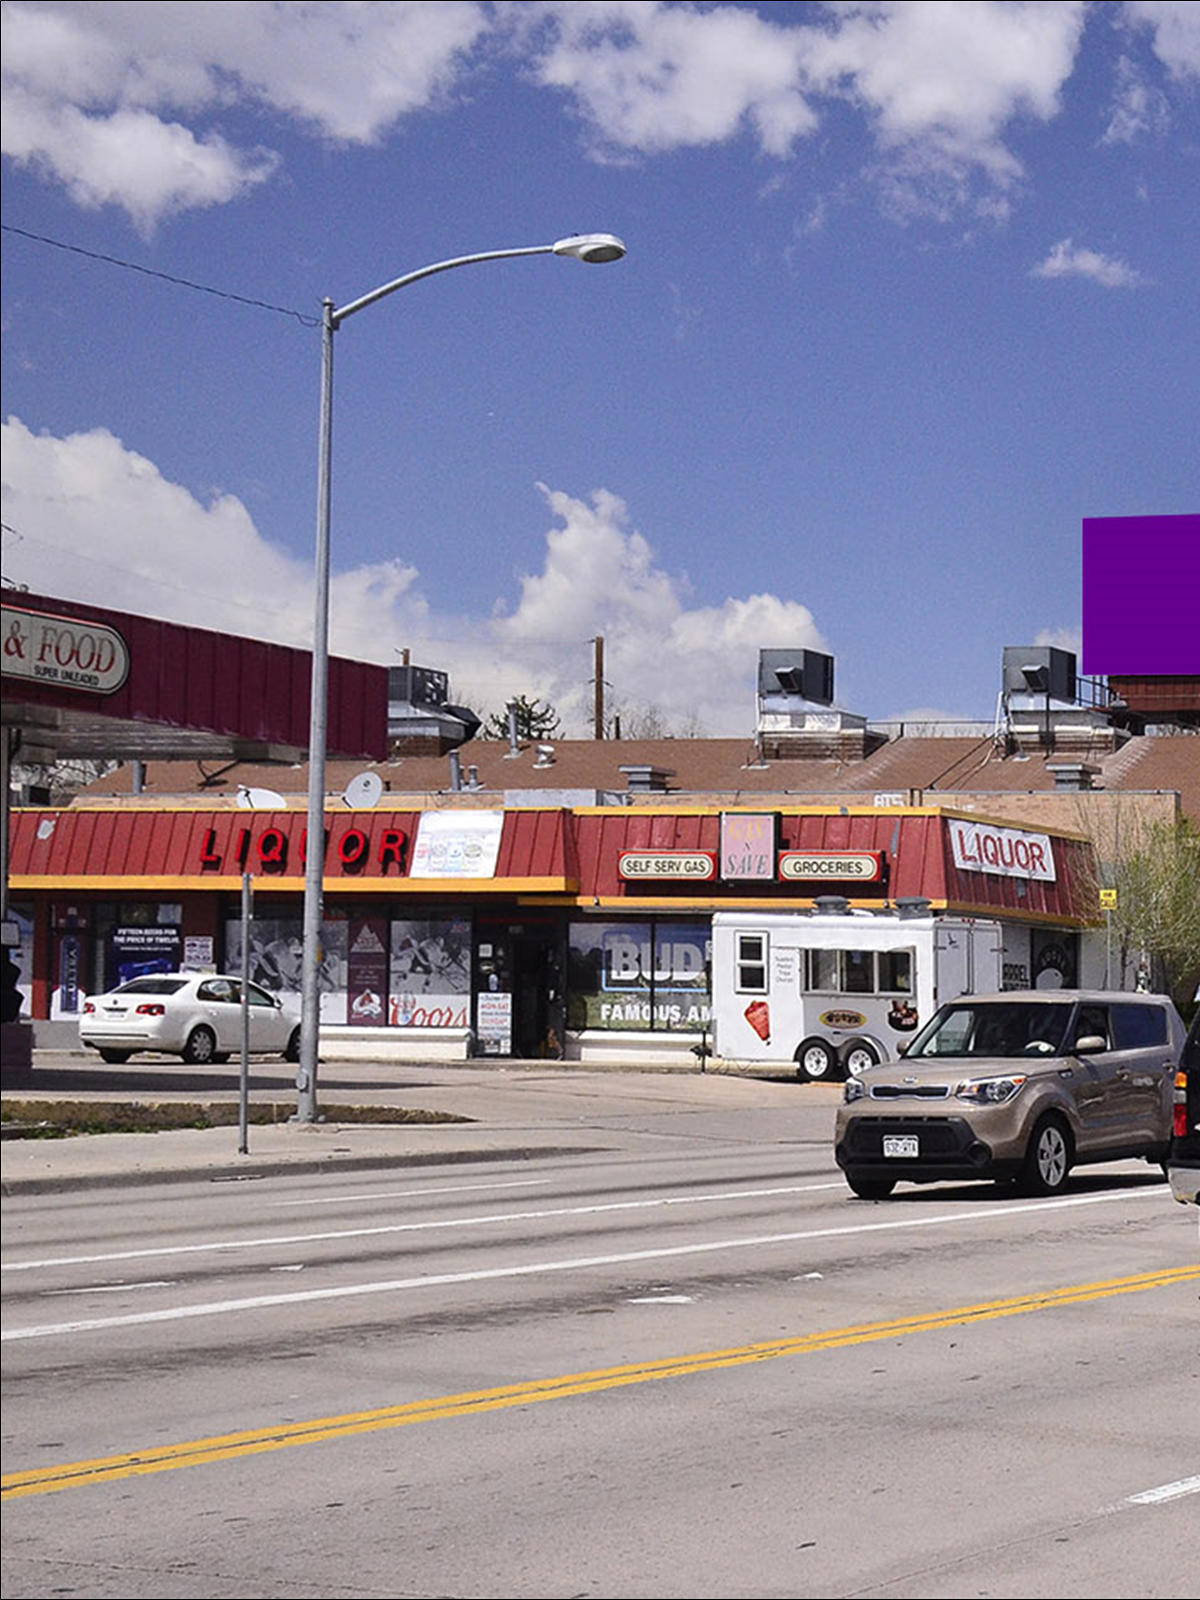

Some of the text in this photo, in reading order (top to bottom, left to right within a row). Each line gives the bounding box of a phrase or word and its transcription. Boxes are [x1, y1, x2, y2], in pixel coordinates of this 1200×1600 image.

[4, 620, 116, 673] & FOOD
[34, 664, 100, 687] SUPER UNLEADED
[729, 820, 764, 839] GAS
[200, 828, 404, 862] LIQOR
[957, 829, 1048, 873] LIQUOR
[626, 859, 706, 874] SELF SERV GAS
[725, 853, 769, 876] SAVE
[793, 857, 863, 874] GROCERIES
[113, 936, 125, 944] THE
[611, 942, 703, 981] BUD
[390, 994, 470, 1027] Coors
[601, 1003, 682, 1023] FAMOUS
